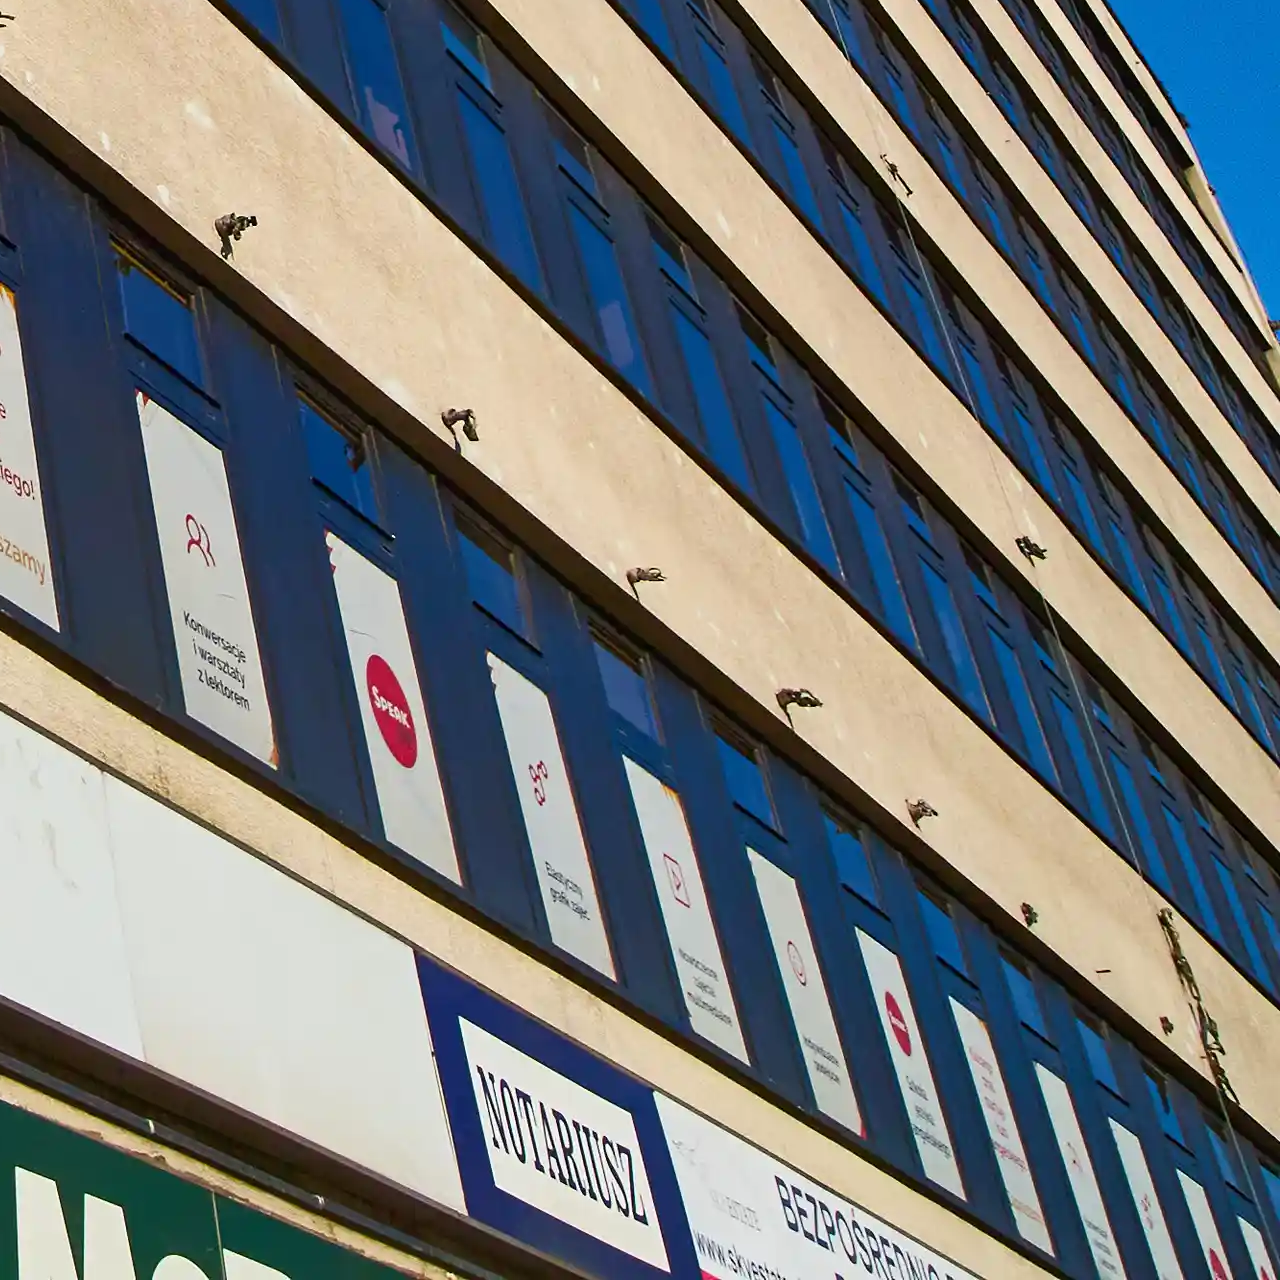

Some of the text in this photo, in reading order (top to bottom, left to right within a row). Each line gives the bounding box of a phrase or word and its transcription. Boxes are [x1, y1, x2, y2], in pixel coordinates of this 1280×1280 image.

[183, 611, 246, 663] Konwersacje
[199, 647, 245, 689] warsztaty
[205, 669, 250, 711] lektorem
[371, 685, 410, 729] SPEAK
[476, 1064, 649, 1226] NOTARIUSZ
[774, 1175, 939, 1280] BEZPOŚRED
